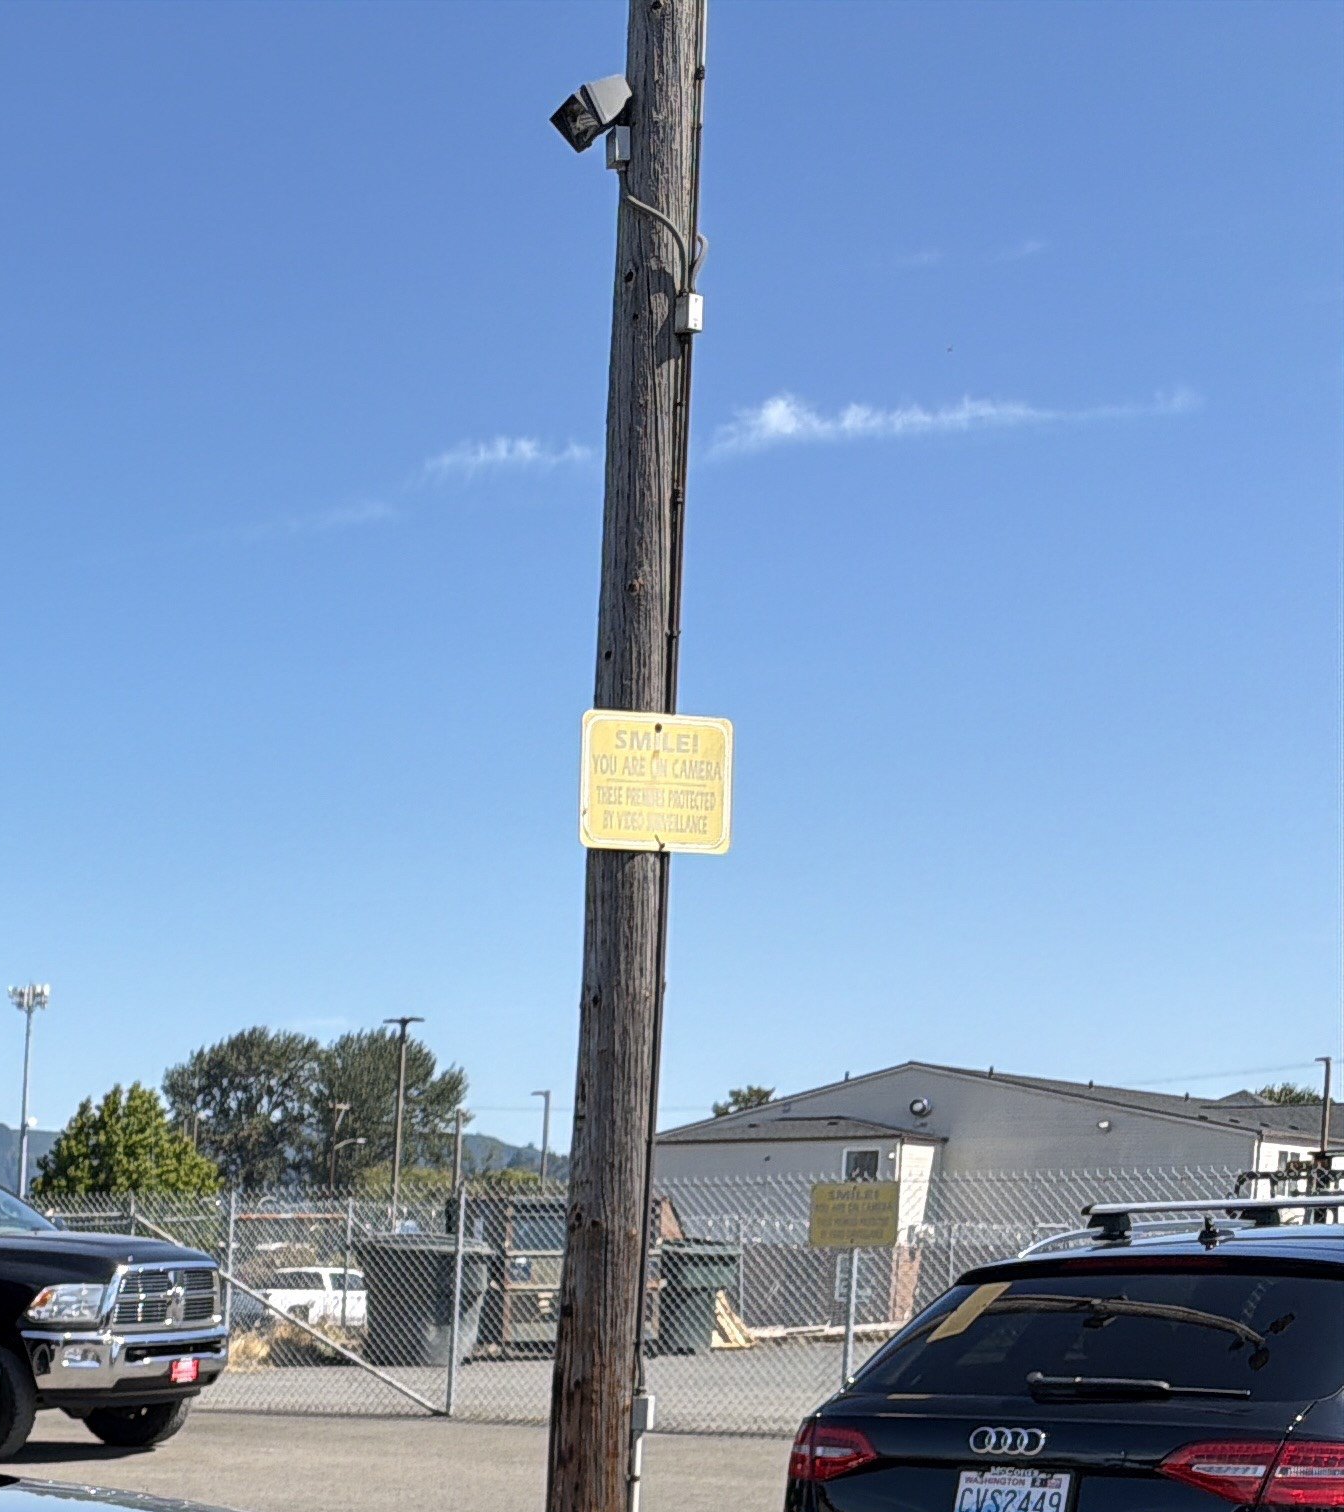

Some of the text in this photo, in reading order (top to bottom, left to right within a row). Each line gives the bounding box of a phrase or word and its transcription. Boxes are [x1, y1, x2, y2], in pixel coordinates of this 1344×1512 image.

[615, 730, 699, 754] SMILE!
[592, 754, 617, 775] YOU
[622, 756, 646, 776] ARE
[672, 759, 722, 781] CAMERA
[596, 786, 623, 805] THESE
[668, 790, 716, 811] PROTECTED
[965, 1477, 1026, 1487] WASHINGTON
